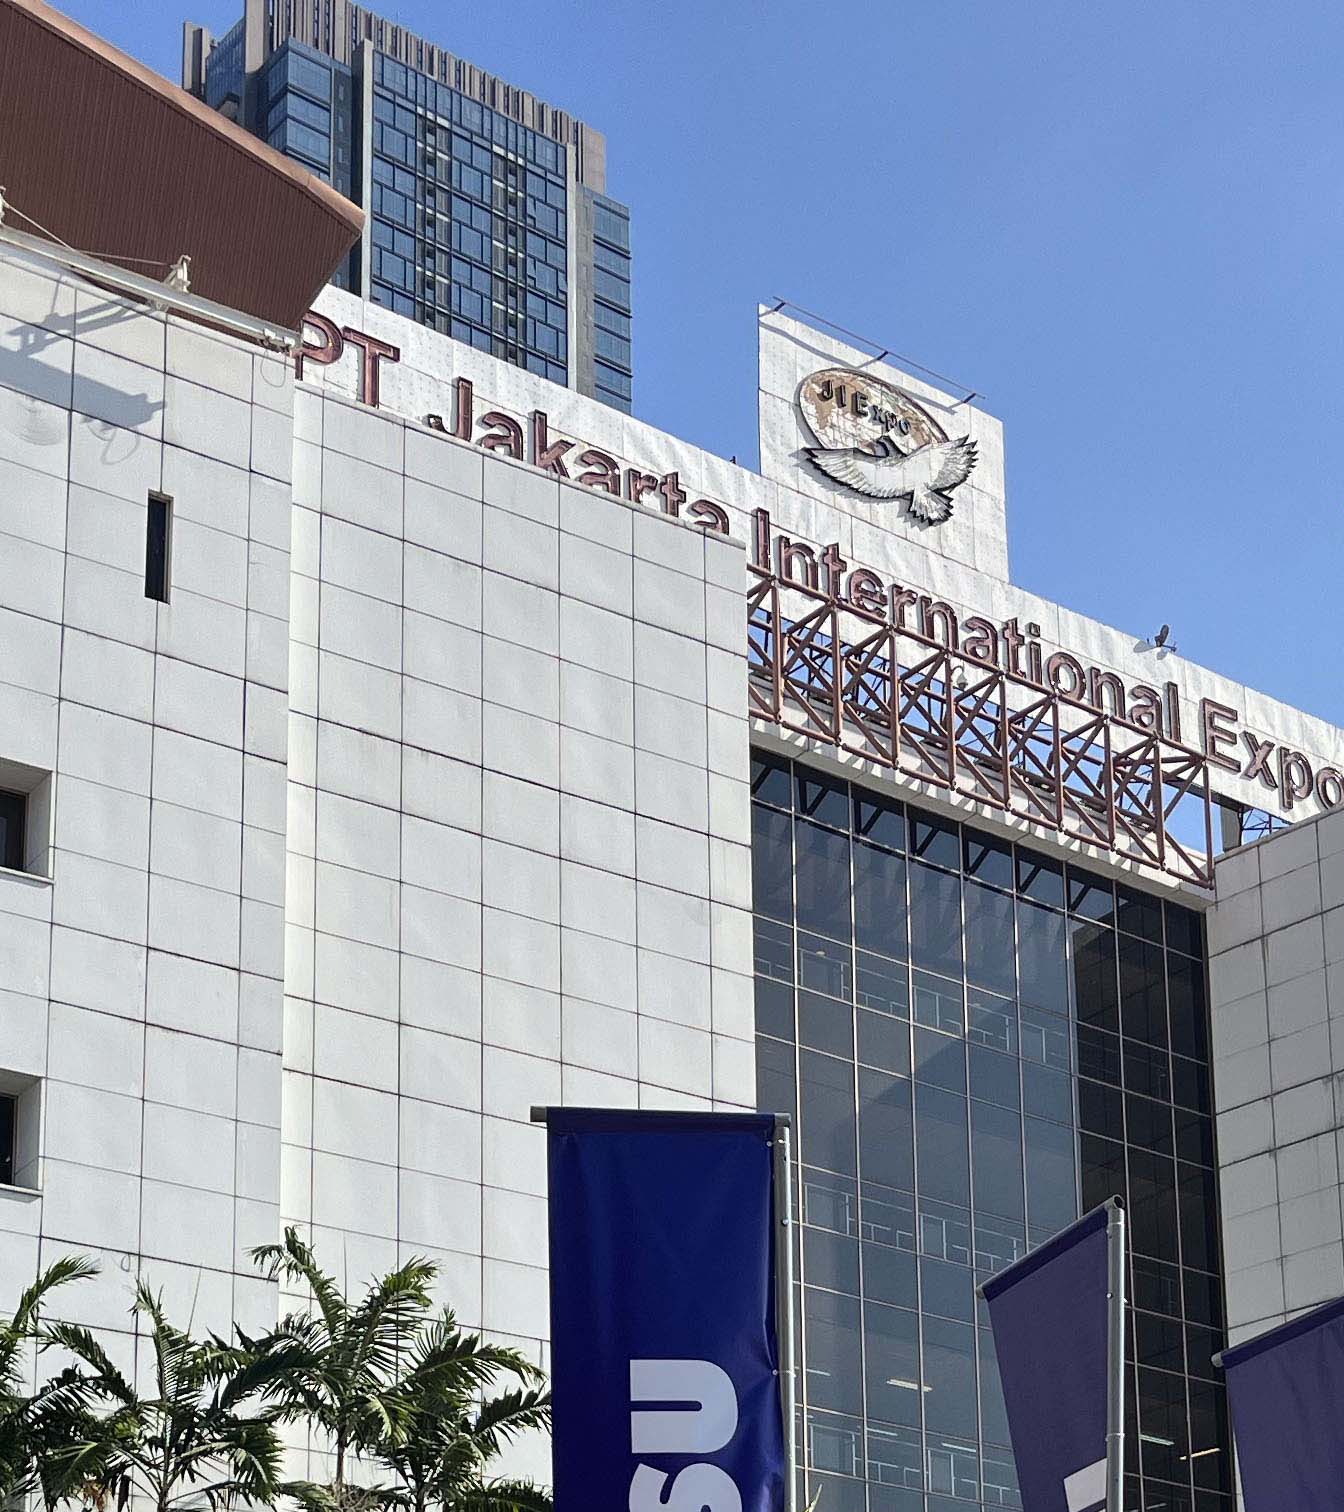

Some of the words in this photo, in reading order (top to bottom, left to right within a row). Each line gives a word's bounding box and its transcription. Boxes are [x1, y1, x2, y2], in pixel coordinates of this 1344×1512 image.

[291, 309, 401, 408] PT
[424, 376, 730, 536] Jakarta
[752, 507, 1182, 744] International
